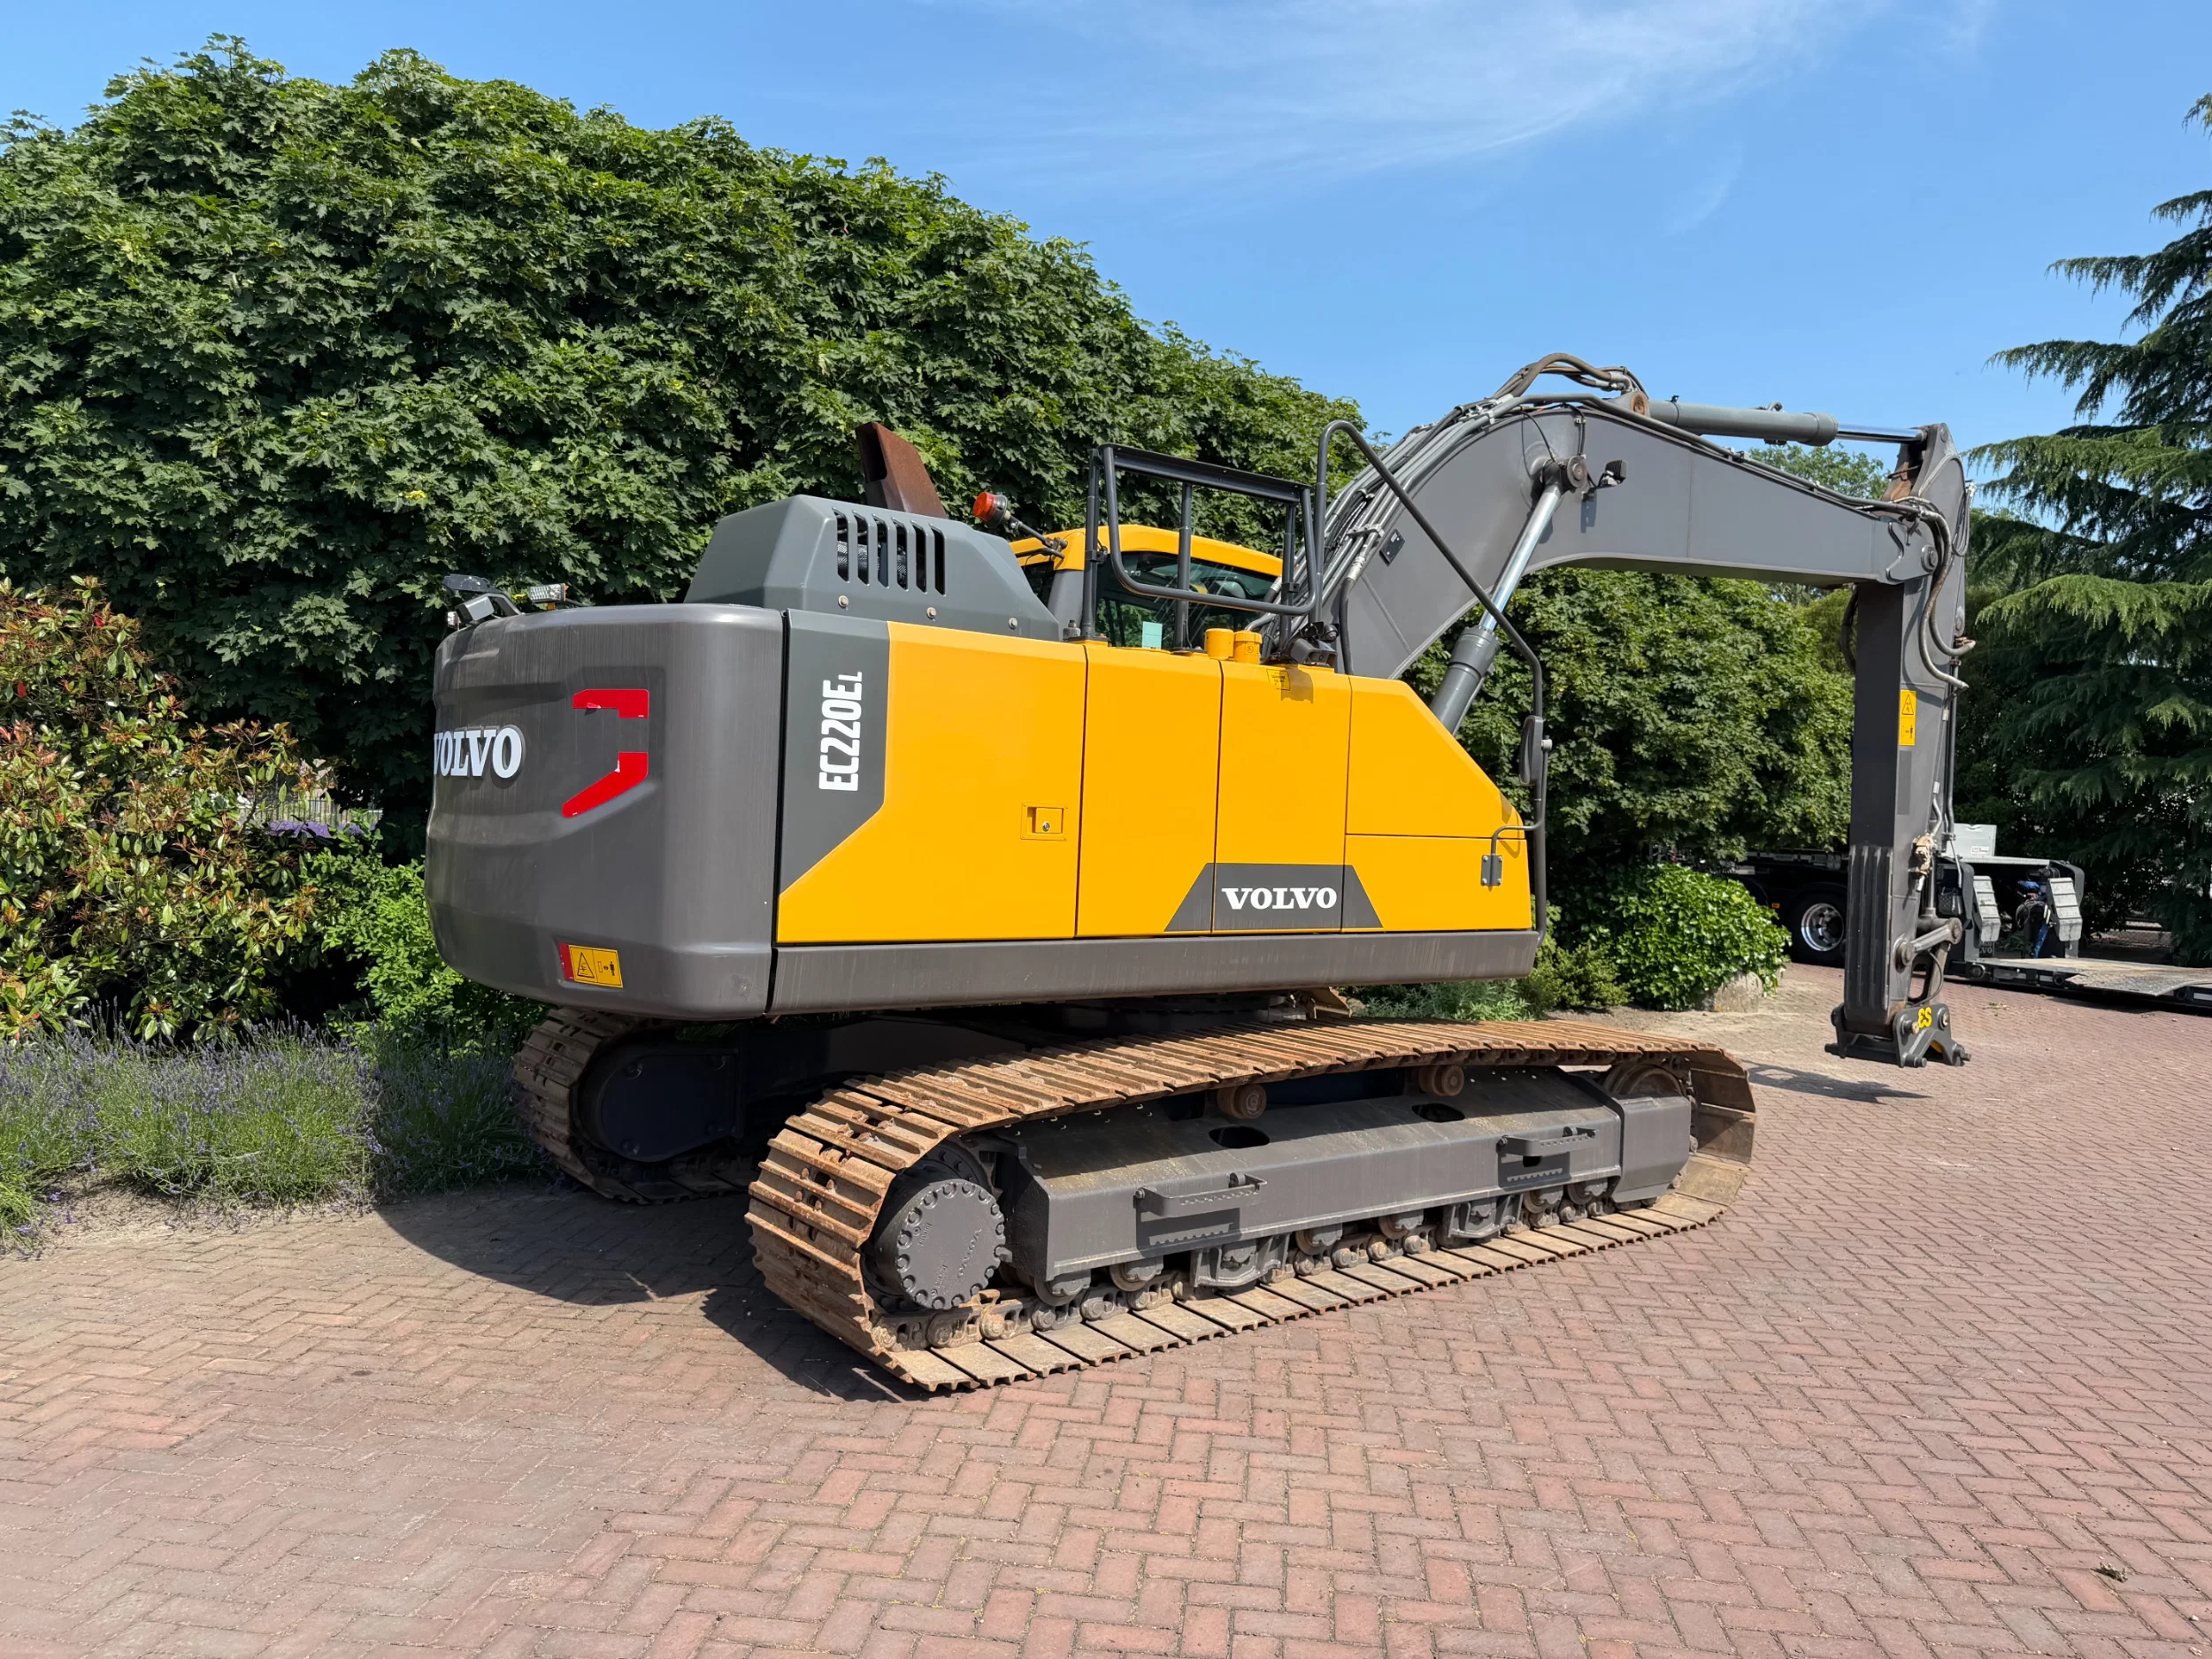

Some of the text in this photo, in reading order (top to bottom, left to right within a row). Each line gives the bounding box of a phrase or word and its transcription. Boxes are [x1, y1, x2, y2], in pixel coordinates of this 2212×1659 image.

[434, 727, 522, 779] VOLVO
[818, 672, 863, 792] EC220EL
[1221, 887, 1338, 910] VOLVO
